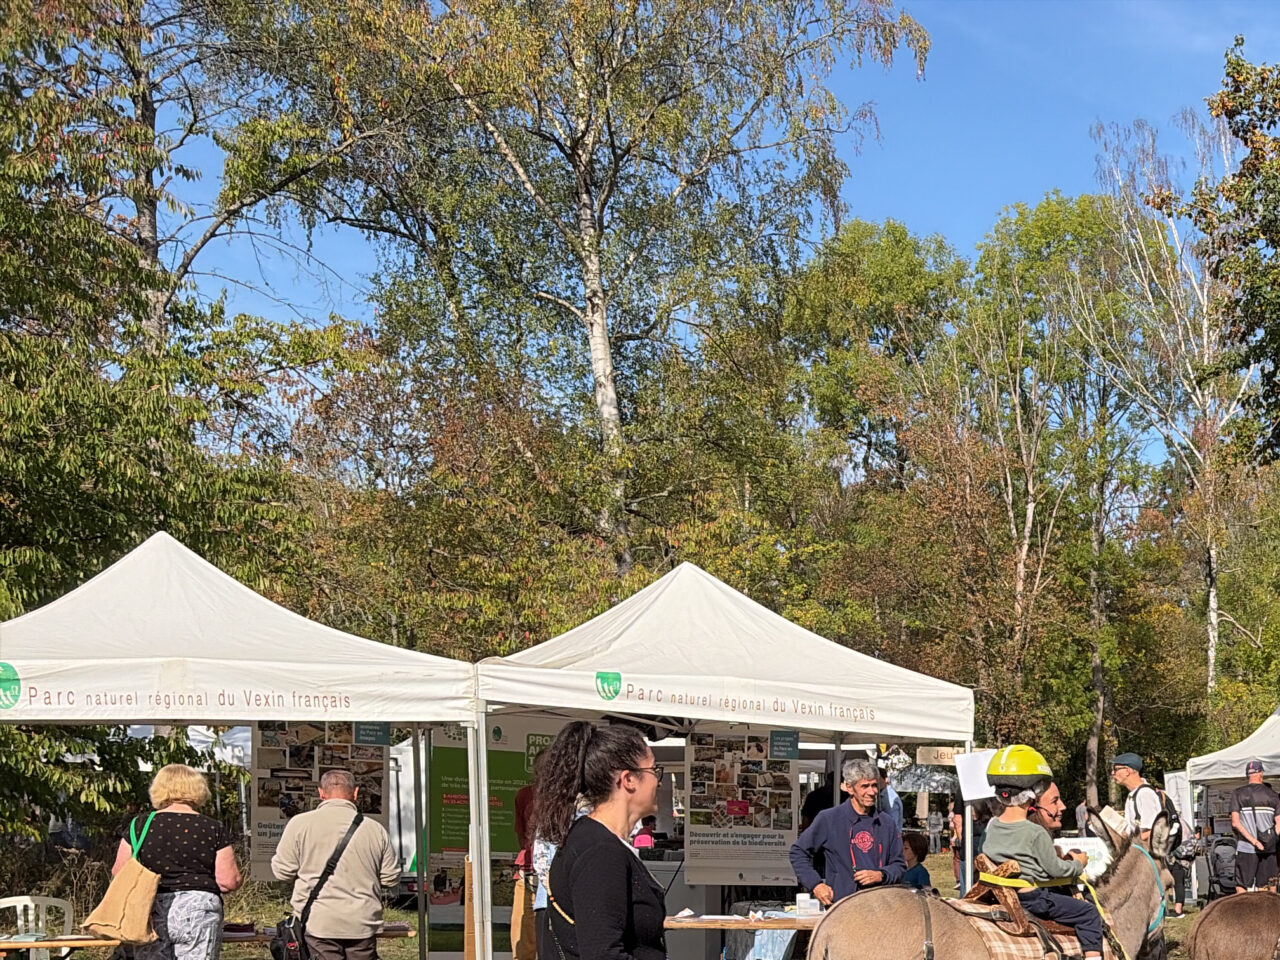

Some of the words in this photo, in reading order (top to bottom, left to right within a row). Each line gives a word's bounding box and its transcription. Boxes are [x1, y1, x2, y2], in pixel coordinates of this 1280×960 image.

[28, 687, 75, 705] Parc
[86, 691, 138, 705] naturel
[148, 691, 208, 709] régional
[218, 689, 235, 706] du
[244, 690, 284, 707] Vexin
[293, 691, 351, 712] français
[626, 684, 663, 702] Parc
[670, 693, 711, 707] naturel
[719, 695, 765, 711] régional
[773, 698, 786, 713] du
[792, 699, 824, 716] Vexin
[830, 702, 875, 722] français
[529, 735, 551, 745] PRO
[730, 832, 761, 840] s'engager
